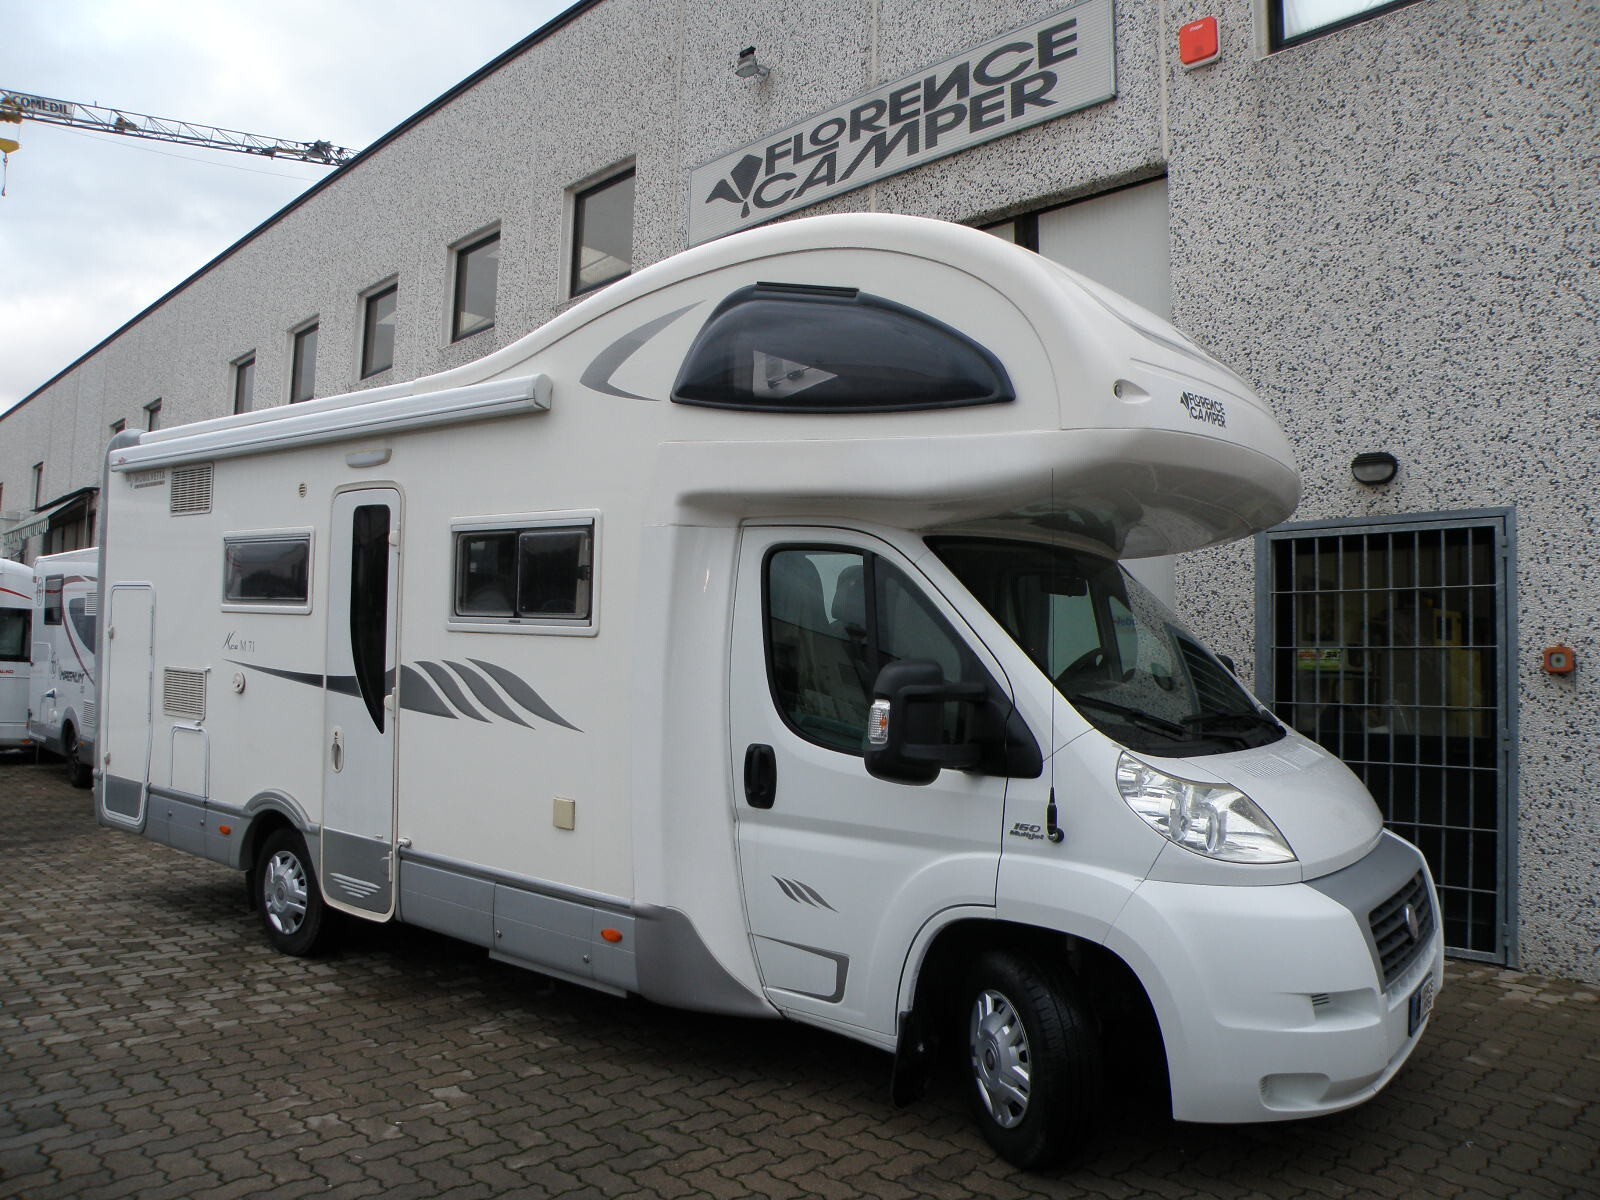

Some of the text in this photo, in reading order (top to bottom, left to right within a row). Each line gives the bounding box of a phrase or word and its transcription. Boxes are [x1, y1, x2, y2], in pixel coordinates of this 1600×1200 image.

[13, 95, 72, 115] COMEDIL
[765, 18, 1078, 177] FLORENCE
[752, 70, 1059, 209] CAMPER
[1187, 392, 1226, 416] FLORENCE
[1189, 406, 1227, 429] CAMPER
[1013, 822, 1041, 833] 160
